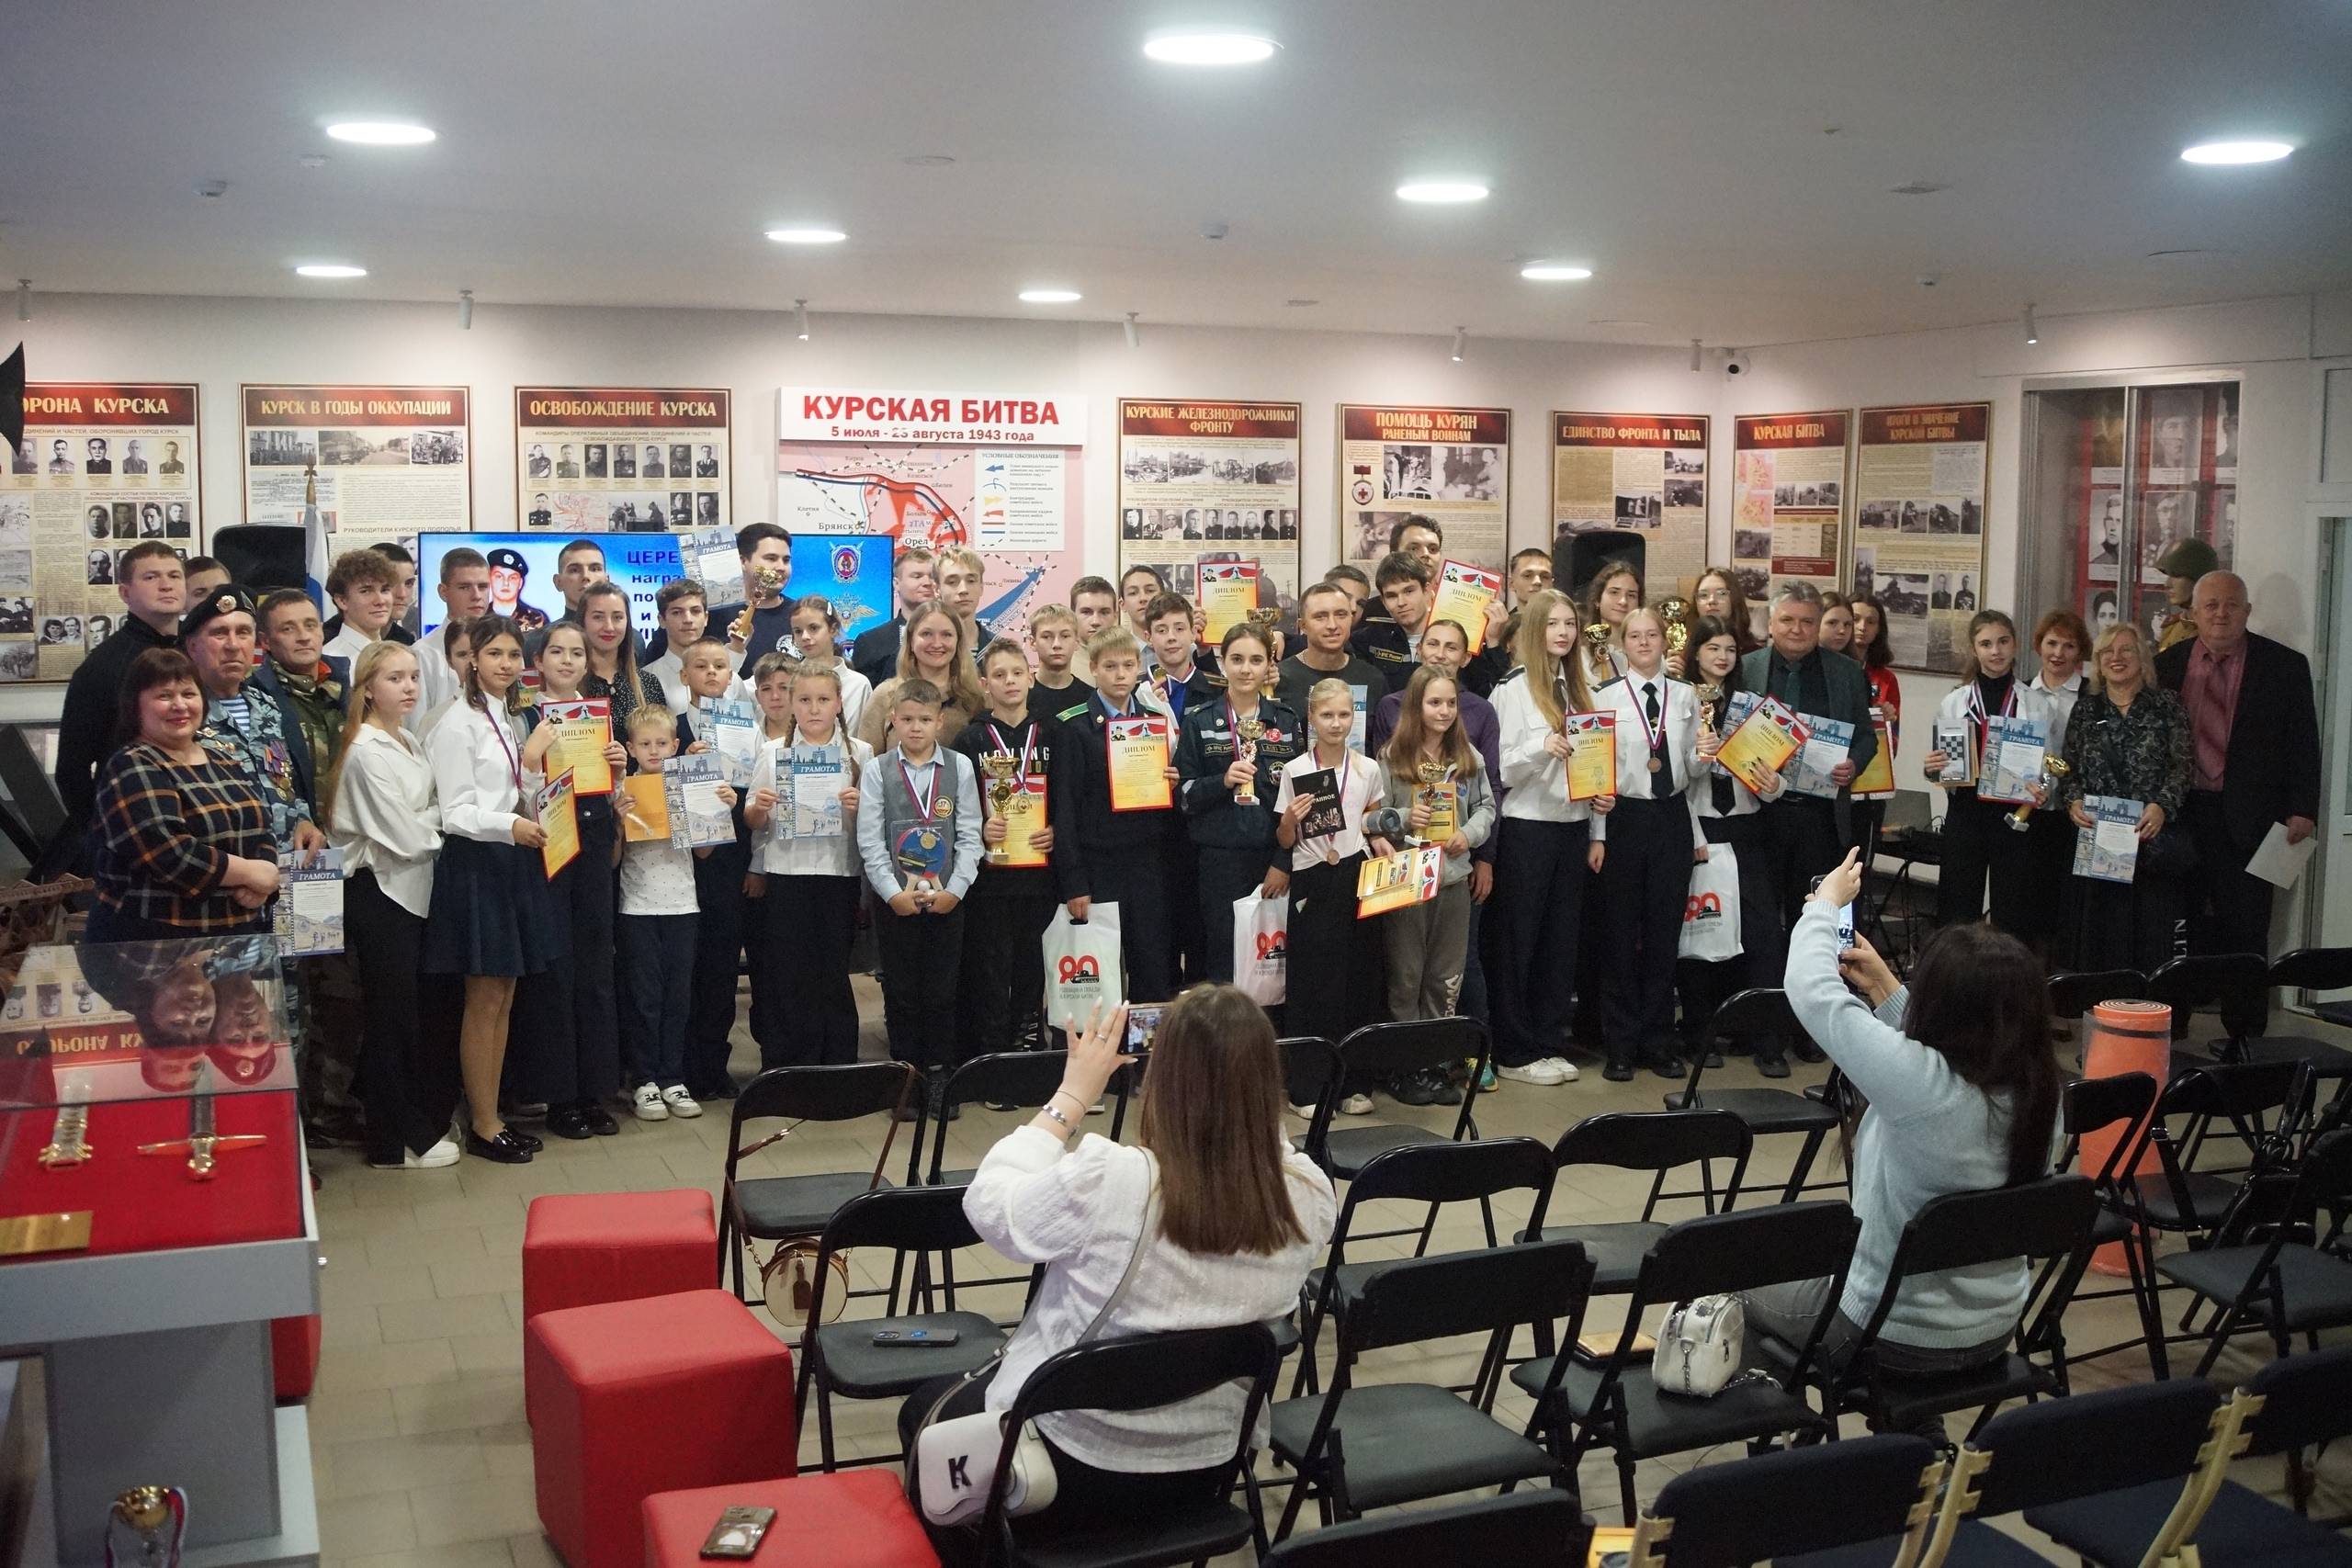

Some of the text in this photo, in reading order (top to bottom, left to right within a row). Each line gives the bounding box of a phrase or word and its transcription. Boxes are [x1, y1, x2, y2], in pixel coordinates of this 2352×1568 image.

[94, 398, 169, 413] КУРСКА
[261, 400, 451, 417] КУРСК В ГОДЫ ОККУПАЦИИ
[529, 400, 717, 417] ОСВОБОЖДЕНИЕ КУРСКА
[804, 395, 1059, 424] КУРСКАЯ БИТВА
[1125, 406, 1295, 422] КУРСКИЕ ЖЕЛЕЗНОДОРОЖНИКИ
[1190, 421, 1235, 434] ФРОНТУ
[1376, 412, 1477, 430] ПОМОЩЬ КУРЯН
[831, 426, 840, 436] 5
[843, 428, 880, 438] июля
[912, 429, 964, 441] августа
[968, 430, 1001, 441] 1943
[1005, 431, 1035, 442] года
[1382, 428, 1471, 441] РАНЕНЫМ ВОИНАМ
[1563, 426, 1702, 441] ЕДИНСТВО ФРОНТА И ТЫЛА
[1754, 423, 1825, 440] КУРСКАЯ БИТВА
[702, 544, 731, 554] ГРАМОТА
[627, 551, 682, 565] ЦЕРЕ
[1213, 586, 1246, 595] ДИПЛОМ
[1451, 587, 1483, 603] ДИПЛОМ
[641, 613, 650, 621] и
[720, 718, 750, 727] ГРАМОТА
[1815, 733, 1847, 746] ГРАМОТА
[2008, 736, 2040, 745] ГРАМОТА
[801, 765, 835, 773] ГРАМОТА
[686, 773, 718, 782] ГРАМОТА
[2104, 815, 2135, 825] ГРАМОТА
